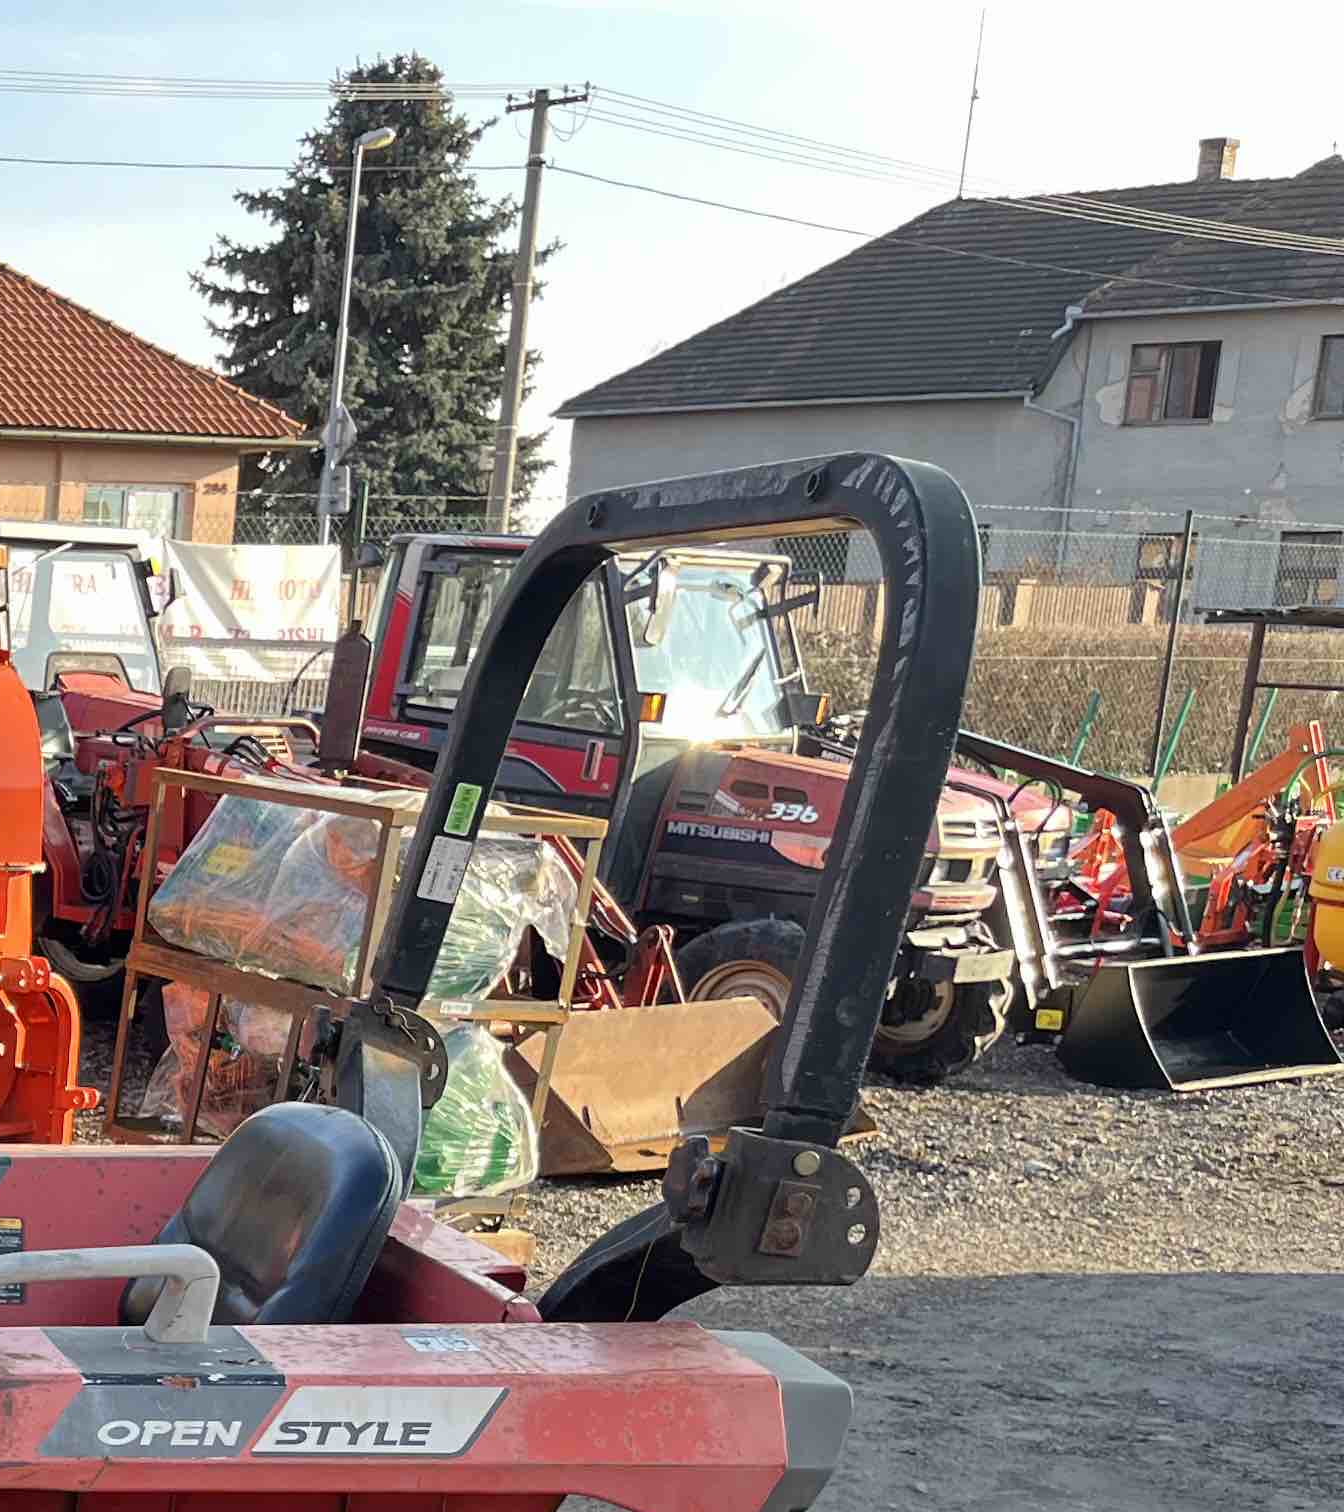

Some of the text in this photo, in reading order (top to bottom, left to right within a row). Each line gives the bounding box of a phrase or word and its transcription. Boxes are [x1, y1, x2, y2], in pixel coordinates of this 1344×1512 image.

[765, 802, 819, 824] 336
[666, 820, 770, 844] MITSUBISHI
[97, 1420, 433, 1447] OPEN STYLE
